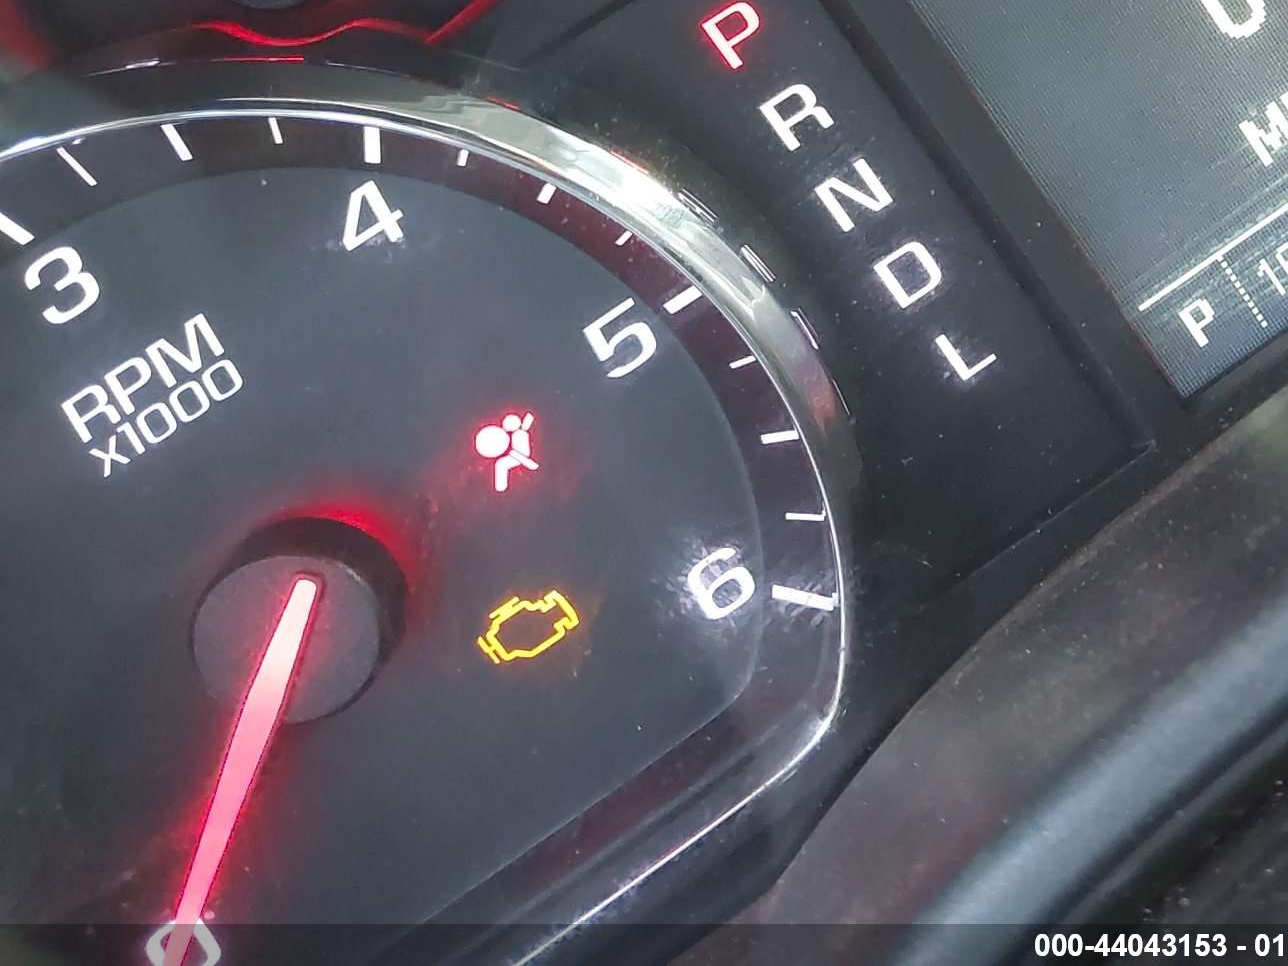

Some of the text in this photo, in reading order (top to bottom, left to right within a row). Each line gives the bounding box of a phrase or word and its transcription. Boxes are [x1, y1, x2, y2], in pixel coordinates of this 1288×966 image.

[701, 1, 761, 70] P
[760, 83, 834, 151] R
[341, 180, 405, 252] 4
[814, 158, 893, 232] N
[23, 246, 101, 325] 3
[874, 241, 942, 308] D
[583, 299, 657, 378] 5
[935, 334, 997, 381] L
[1179, 298, 1216, 347] P
[60, 312, 225, 444] RPM
[89, 358, 243, 477] x1000
[686, 548, 755, 620] 6
